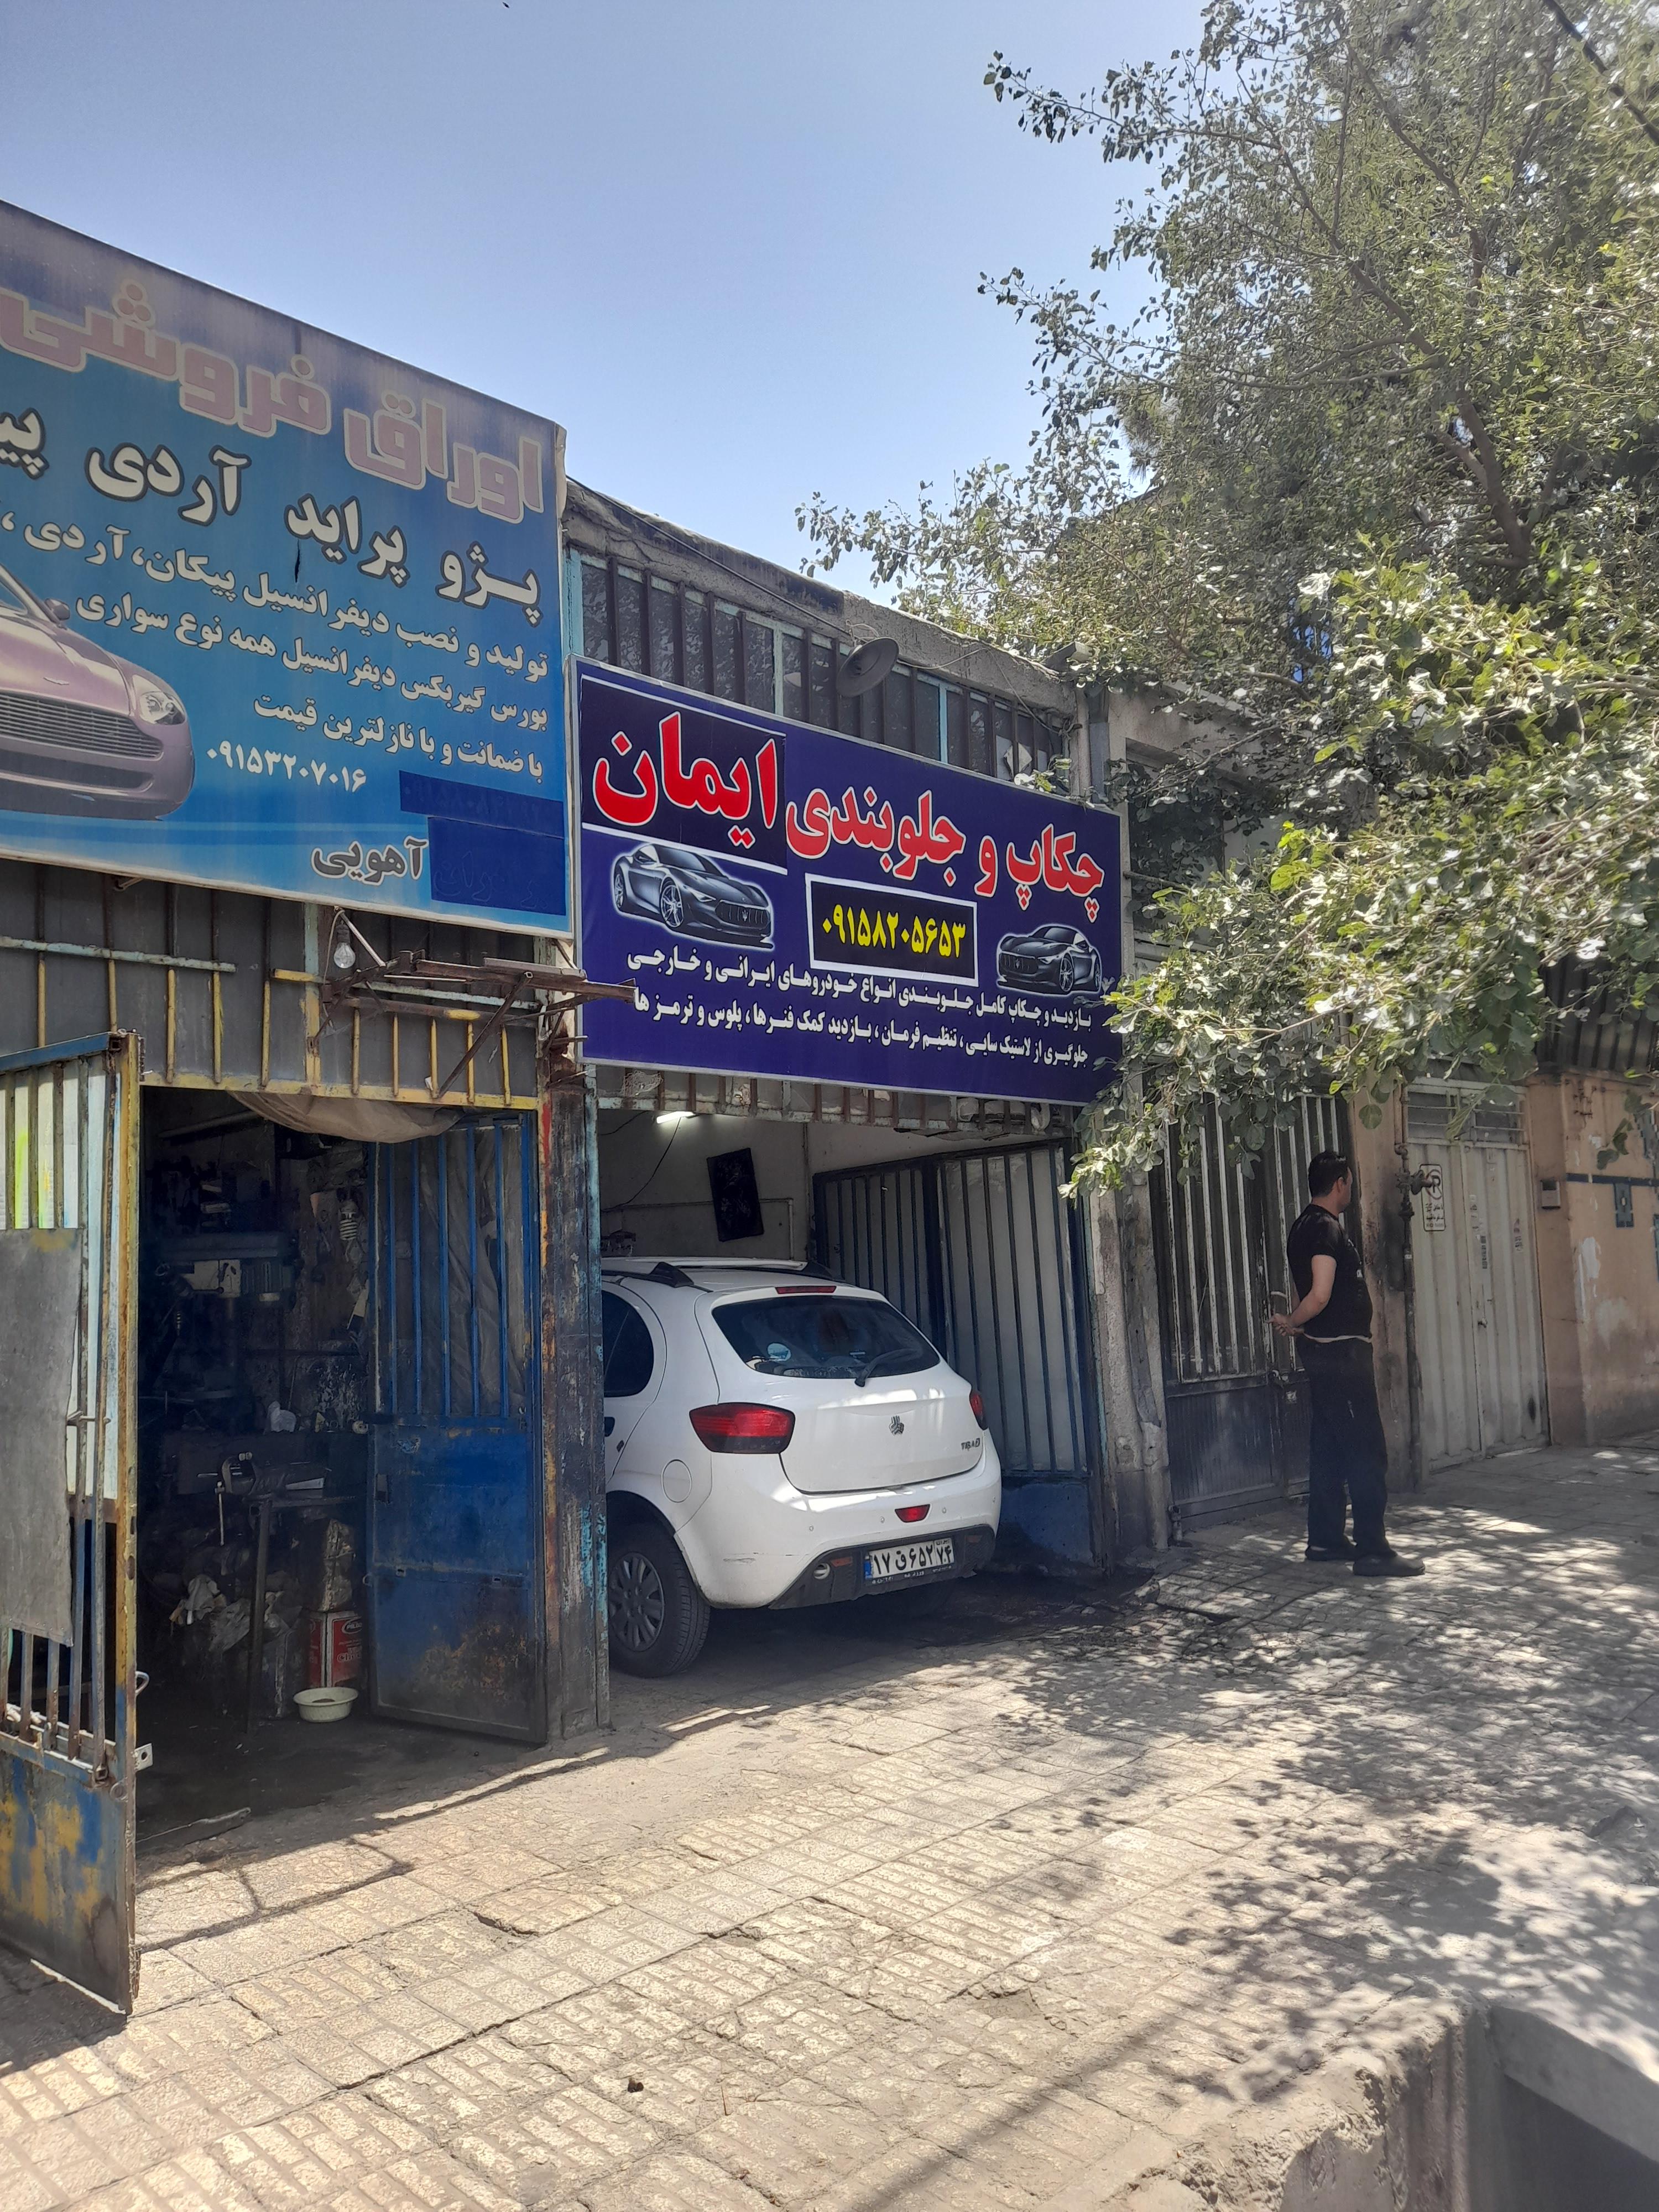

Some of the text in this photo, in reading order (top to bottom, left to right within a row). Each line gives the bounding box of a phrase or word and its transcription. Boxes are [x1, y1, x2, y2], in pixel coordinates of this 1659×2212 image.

[0, 279, 544, 524] اوراق فروشی
[85, 442, 252, 526] آردی
[24, 522, 131, 565] آردی
[284, 493, 410, 588] پراید
[436, 540, 544, 628] پژو
[76, 592, 169, 633] سواری
[174, 612, 223, 650] نوع
[228, 627, 276, 657] همه
[396, 626, 460, 653] نصب
[466, 643, 481, 667] و
[486, 645, 548, 683] تولید
[400, 676, 486, 714] گیربکس
[253, 694, 317, 731] قیمت
[490, 703, 549, 732] بورس
[419, 727, 435, 759] با
[440, 742, 453, 765] و
[456, 740, 526, 772] ضمانت
[207, 740, 366, 792] ۰۹۱۵۳۲۰۷۰۱۶
[527, 752, 544, 784] با
[593, 712, 778, 849] ایمان
[786, 786, 966, 887] جلوبندی
[311, 835, 429, 886] آهویی
[975, 836, 998, 897] و
[1006, 823, 1104, 923] چکاپ
[822, 904, 966, 959] ۰۹۱۵۸۲۰۵۶۵۳
[627, 945, 1092, 1032] بازدید و چکاپ کامل جلوبندی انواع خودروهای ایرانی و خارجی
[653, 994, 695, 1024] ترمز
[696, 1007, 706, 1026] و
[708, 1000, 743, 1031] پلوس
[796, 1009, 826, 1033] کمک
[827, 1015, 872, 1044] بازدید
[881, 1019, 921, 1049] فرمان
[922, 1025, 958, 1051] تنظیم
[966, 1032, 998, 1056] سایی
[999, 1035, 1031, 1060] لاستیک
[1033, 1041, 1043, 1064] از
[1044, 1044, 1088, 1068] جلوگیری
